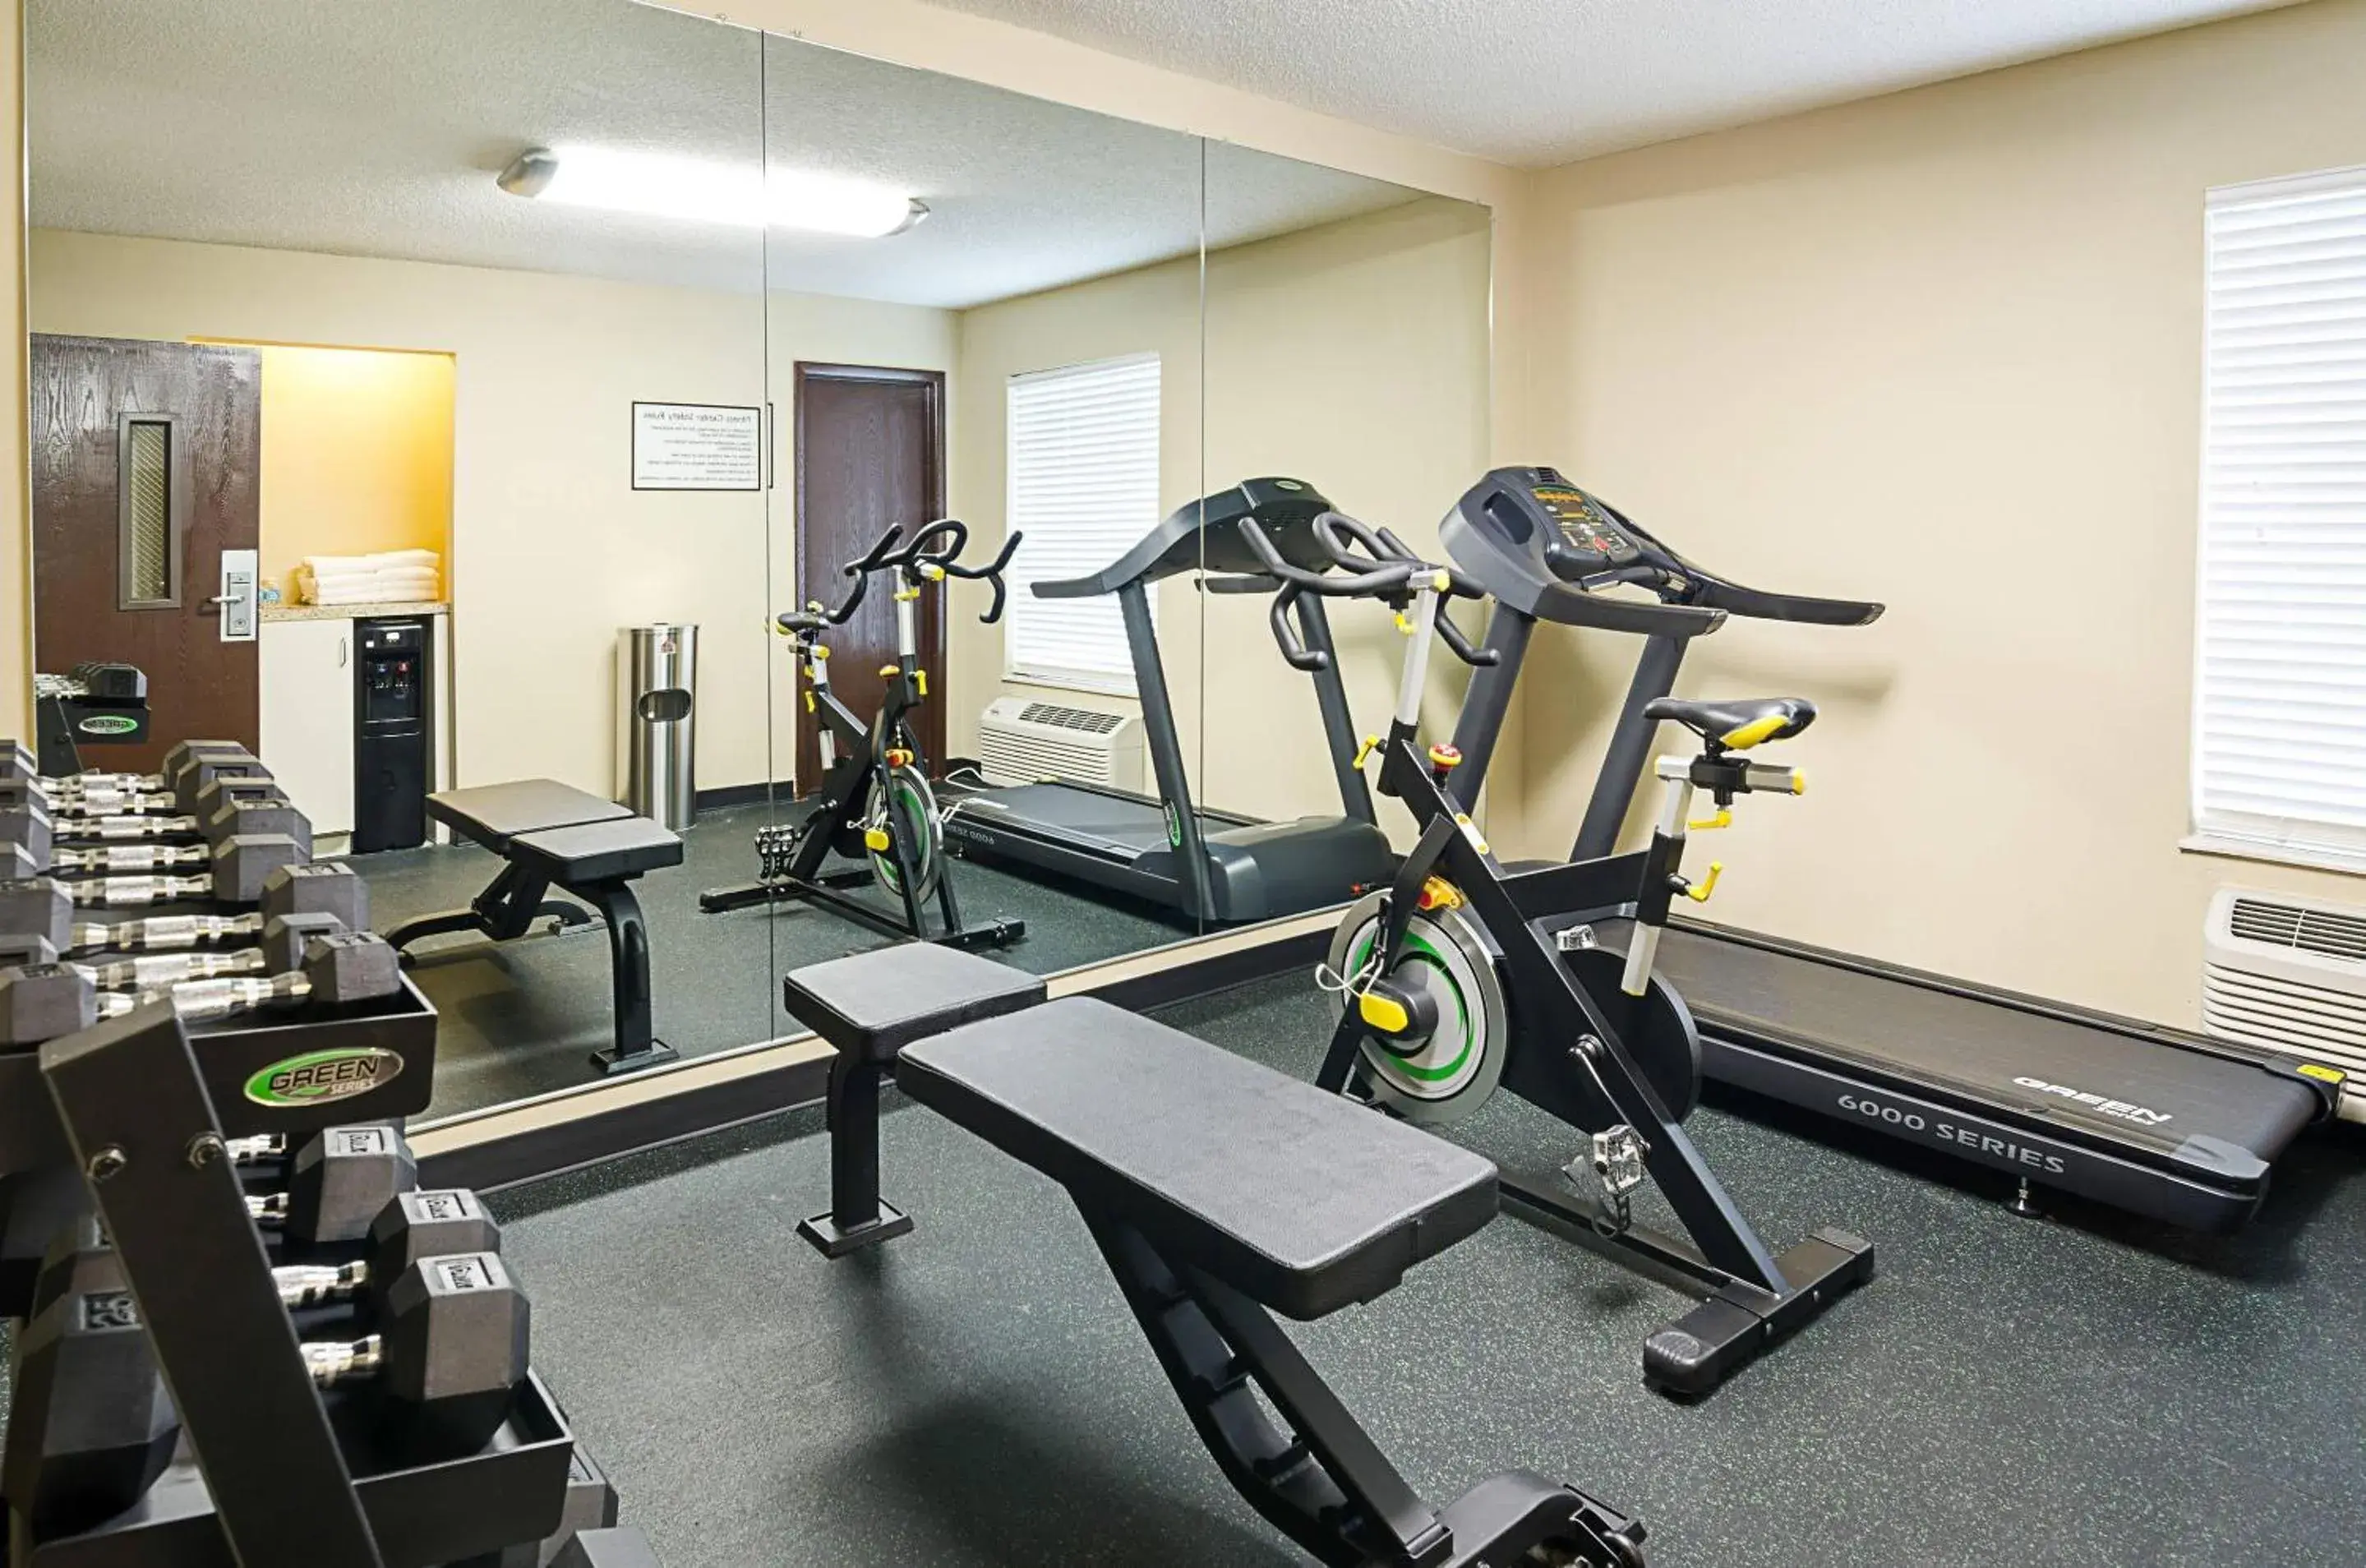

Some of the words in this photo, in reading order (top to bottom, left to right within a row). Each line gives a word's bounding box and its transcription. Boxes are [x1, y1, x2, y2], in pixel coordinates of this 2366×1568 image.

[269, 1056, 379, 1091] GREEN
[330, 1078, 376, 1095] SERIES
[1838, 1094, 1926, 1131] 6000
[1935, 1123, 2064, 1174] SERIES
